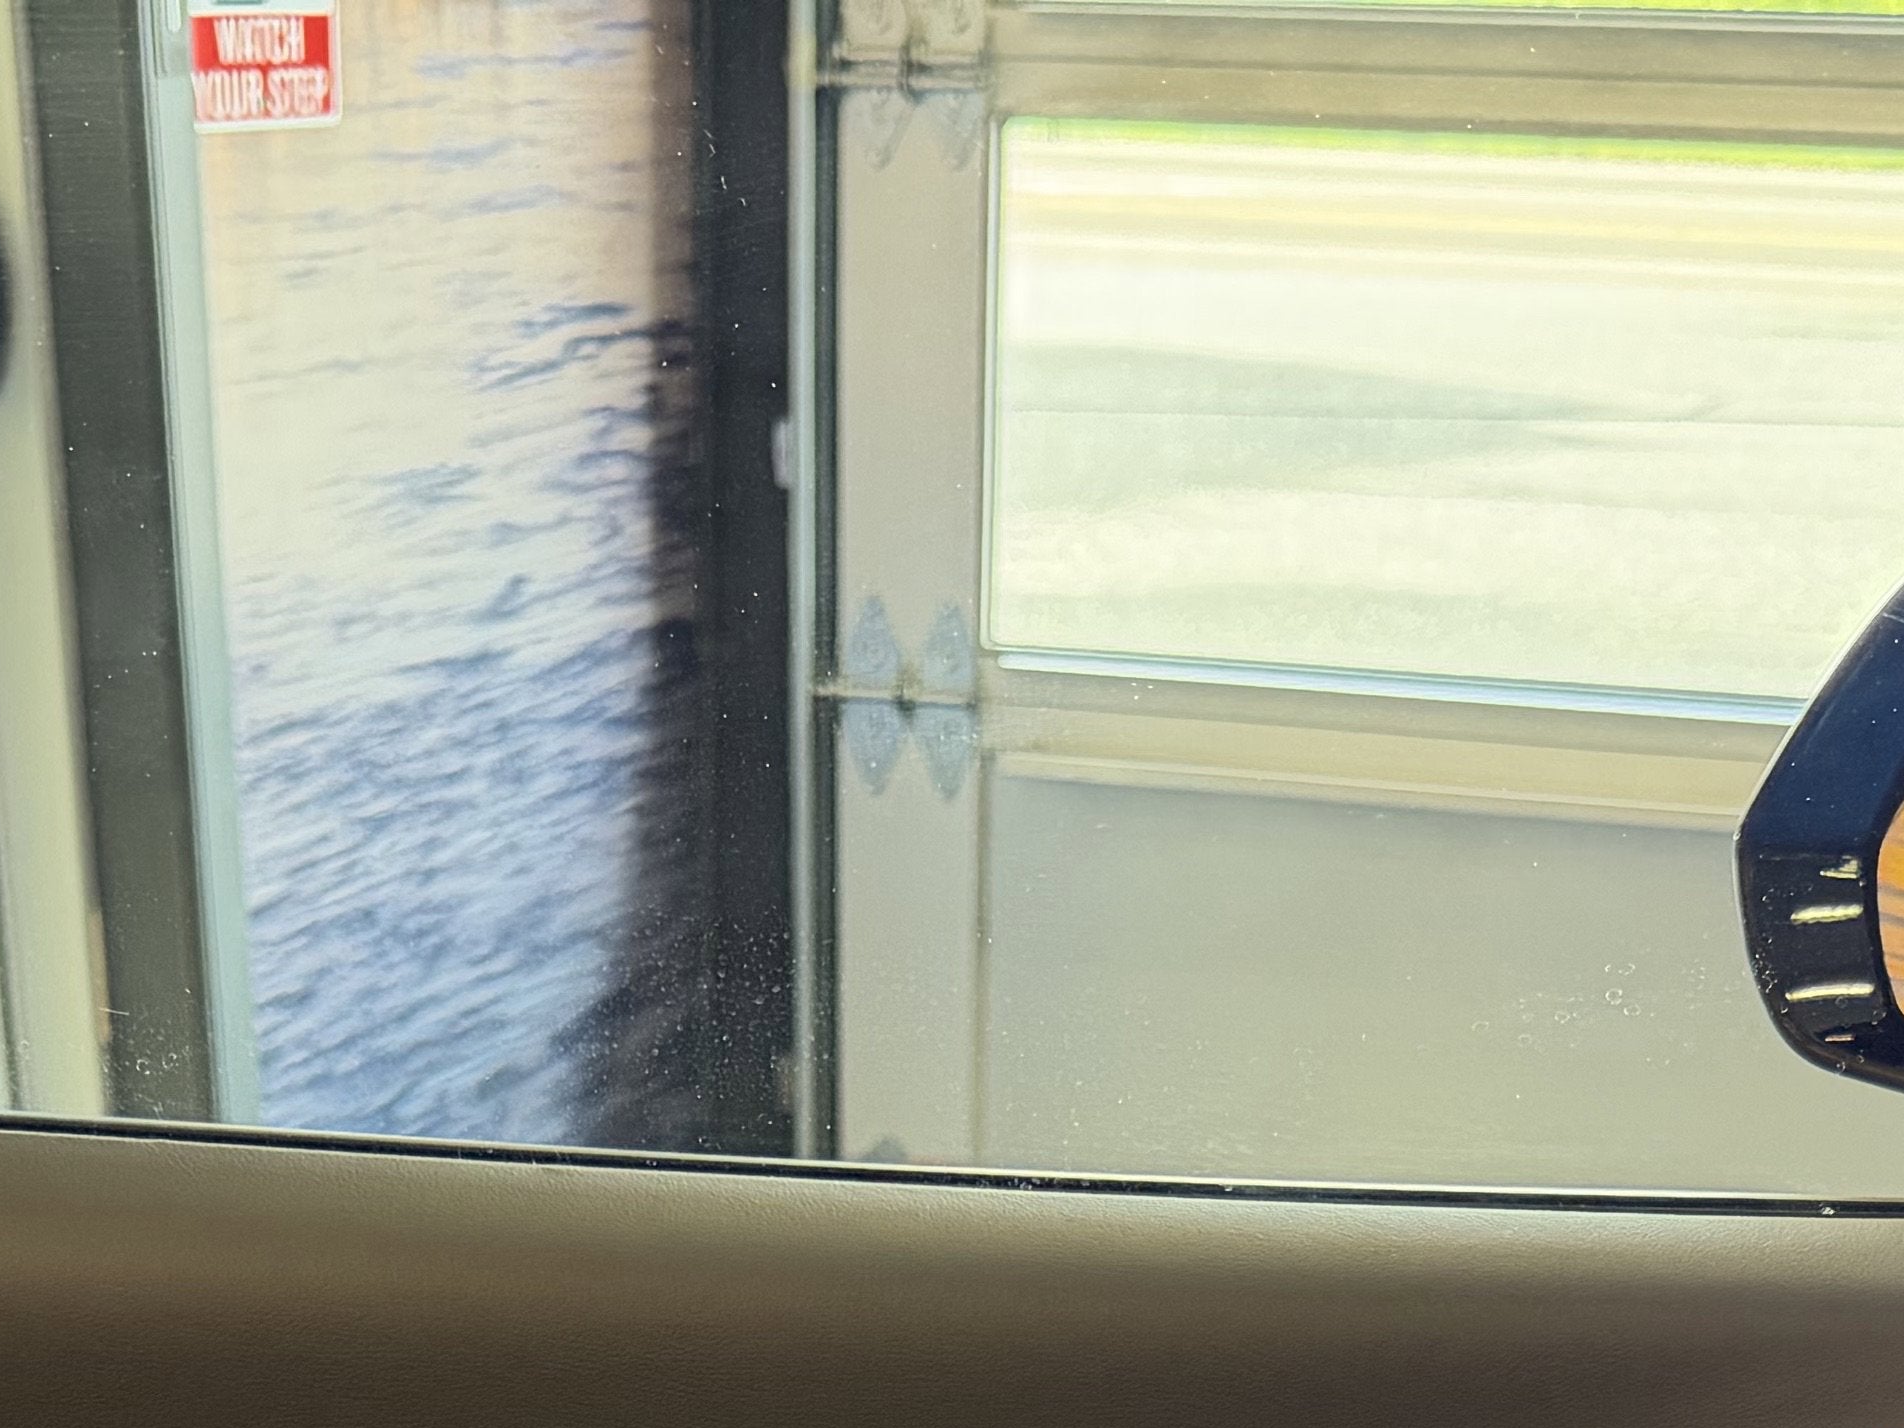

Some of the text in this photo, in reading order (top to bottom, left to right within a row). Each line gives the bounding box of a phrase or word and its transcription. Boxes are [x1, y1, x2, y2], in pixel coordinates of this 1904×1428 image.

[213, 16, 305, 65] WATCH
[192, 66, 329, 121] YOUR STEP
